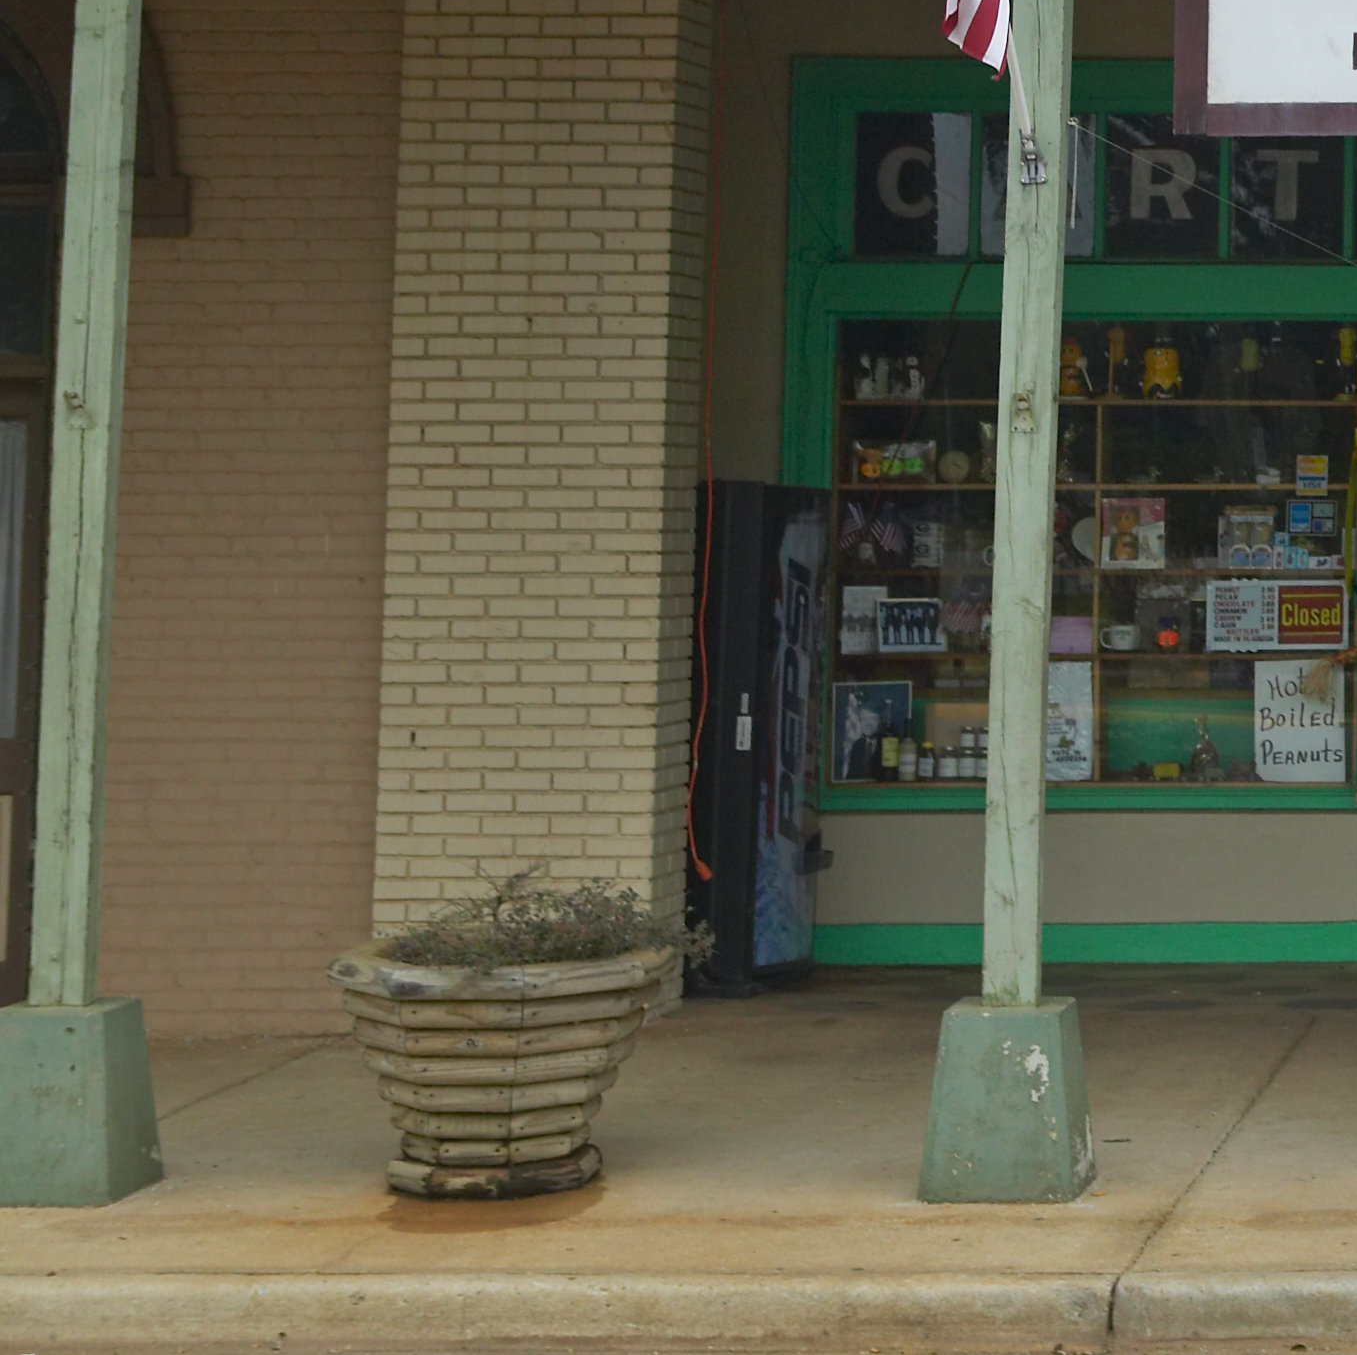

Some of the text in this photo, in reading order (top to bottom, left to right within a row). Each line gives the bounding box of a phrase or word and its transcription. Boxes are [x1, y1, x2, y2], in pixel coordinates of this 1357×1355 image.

[1281, 602, 1341, 626] Closed
[778, 556, 813, 843] PEPSI
[1267, 667, 1305, 700] Hot
